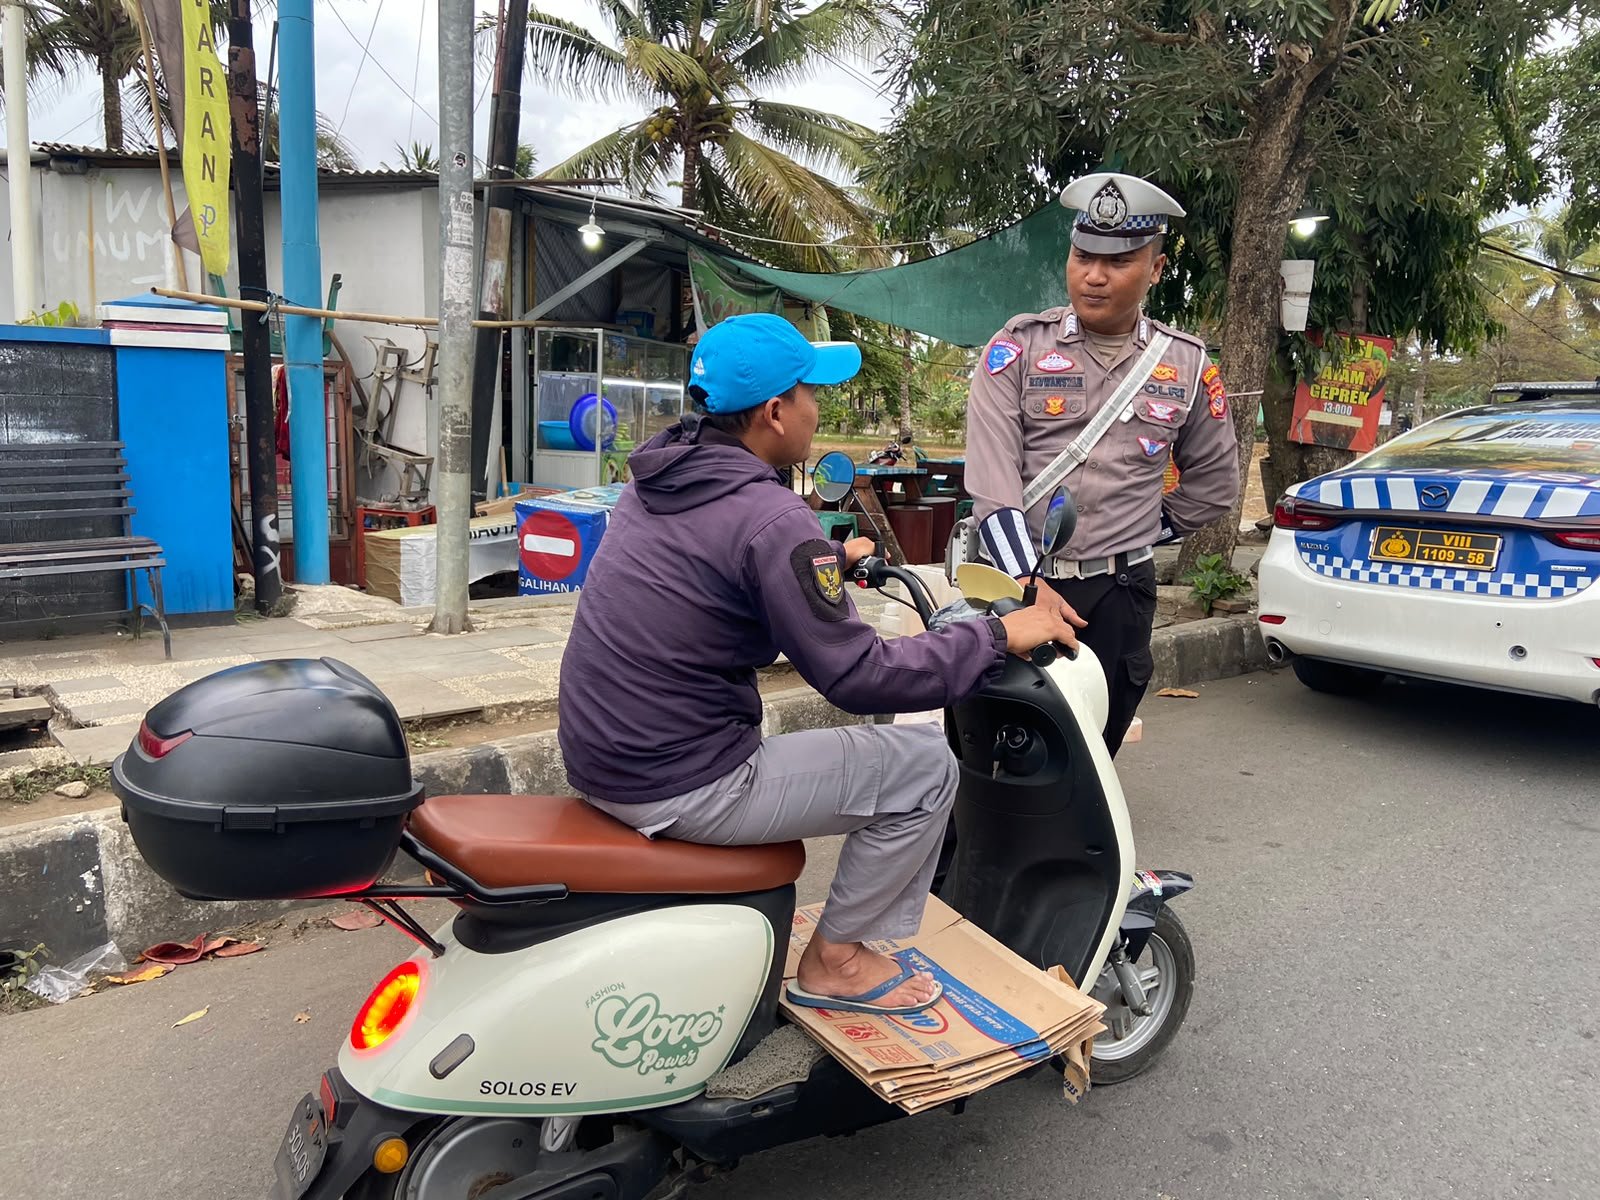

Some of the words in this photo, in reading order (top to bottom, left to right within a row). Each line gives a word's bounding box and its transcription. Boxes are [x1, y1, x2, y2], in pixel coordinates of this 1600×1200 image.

[196, 0, 217, 184] ARAN
[1144, 383, 1186, 399] OLRI
[1309, 384, 1370, 407] GEPREK
[1443, 534, 1472, 548] VIII
[1422, 548, 1455, 562] 1109
[1467, 552, 1485, 565] 58
[585, 982, 626, 1009] FASHION
[592, 992, 723, 1068] Love
[638, 1044, 699, 1075] Power
[479, 1080, 546, 1096] SOLOS
[550, 1082, 578, 1096] EV
